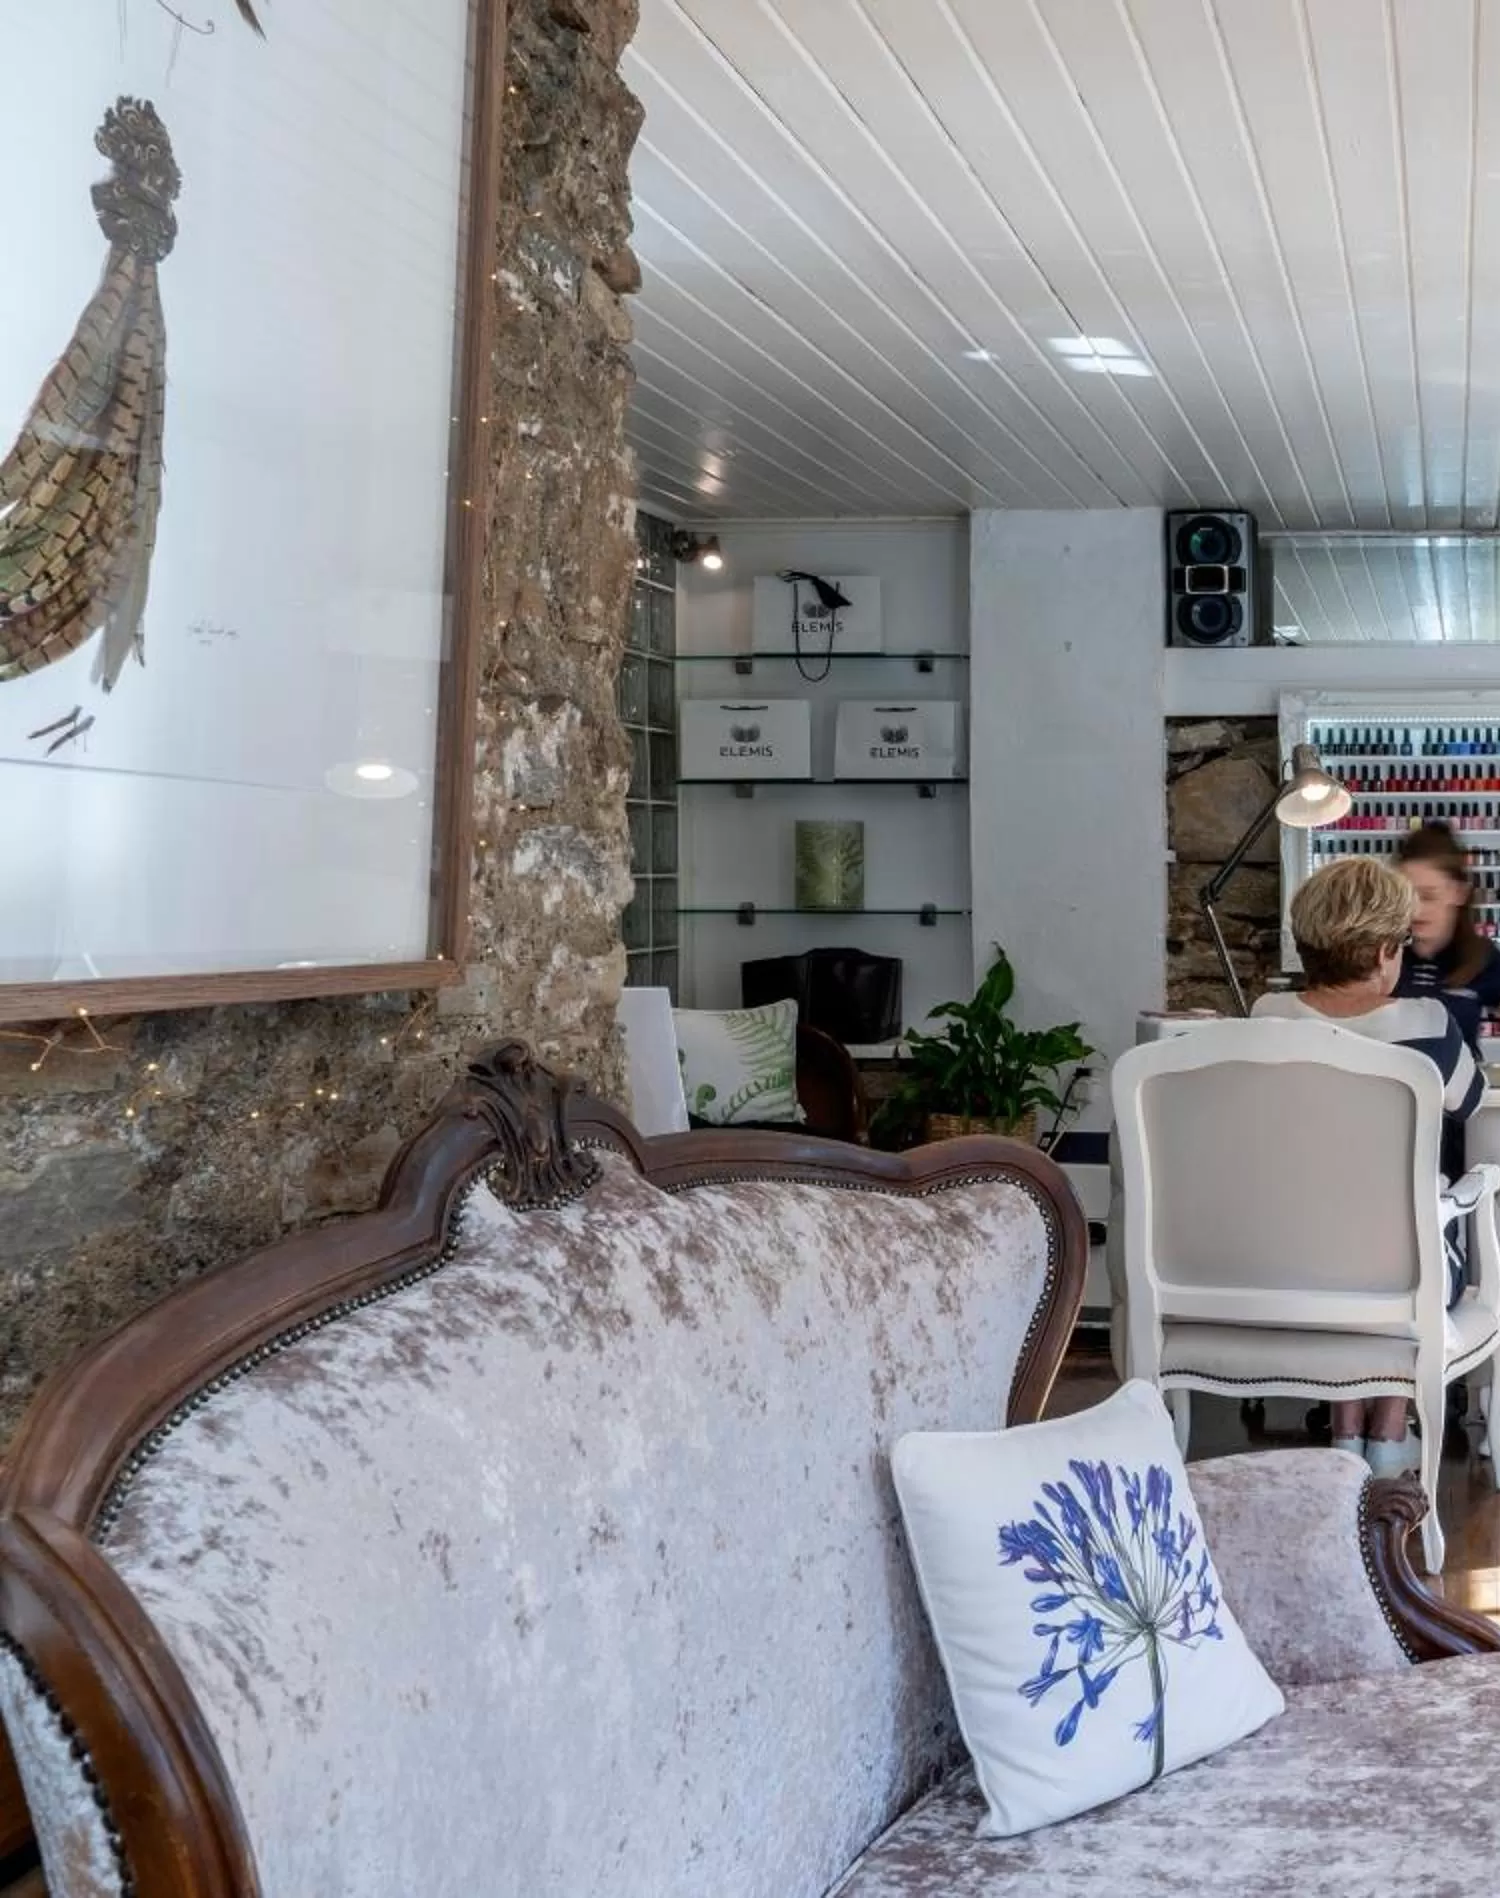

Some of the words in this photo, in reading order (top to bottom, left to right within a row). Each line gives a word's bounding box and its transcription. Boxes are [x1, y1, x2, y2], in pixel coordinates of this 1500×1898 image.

[791, 621, 844, 633] ELEMS
[719, 746, 773, 757] ELEMIS
[869, 747, 921, 759] ELEMIS
